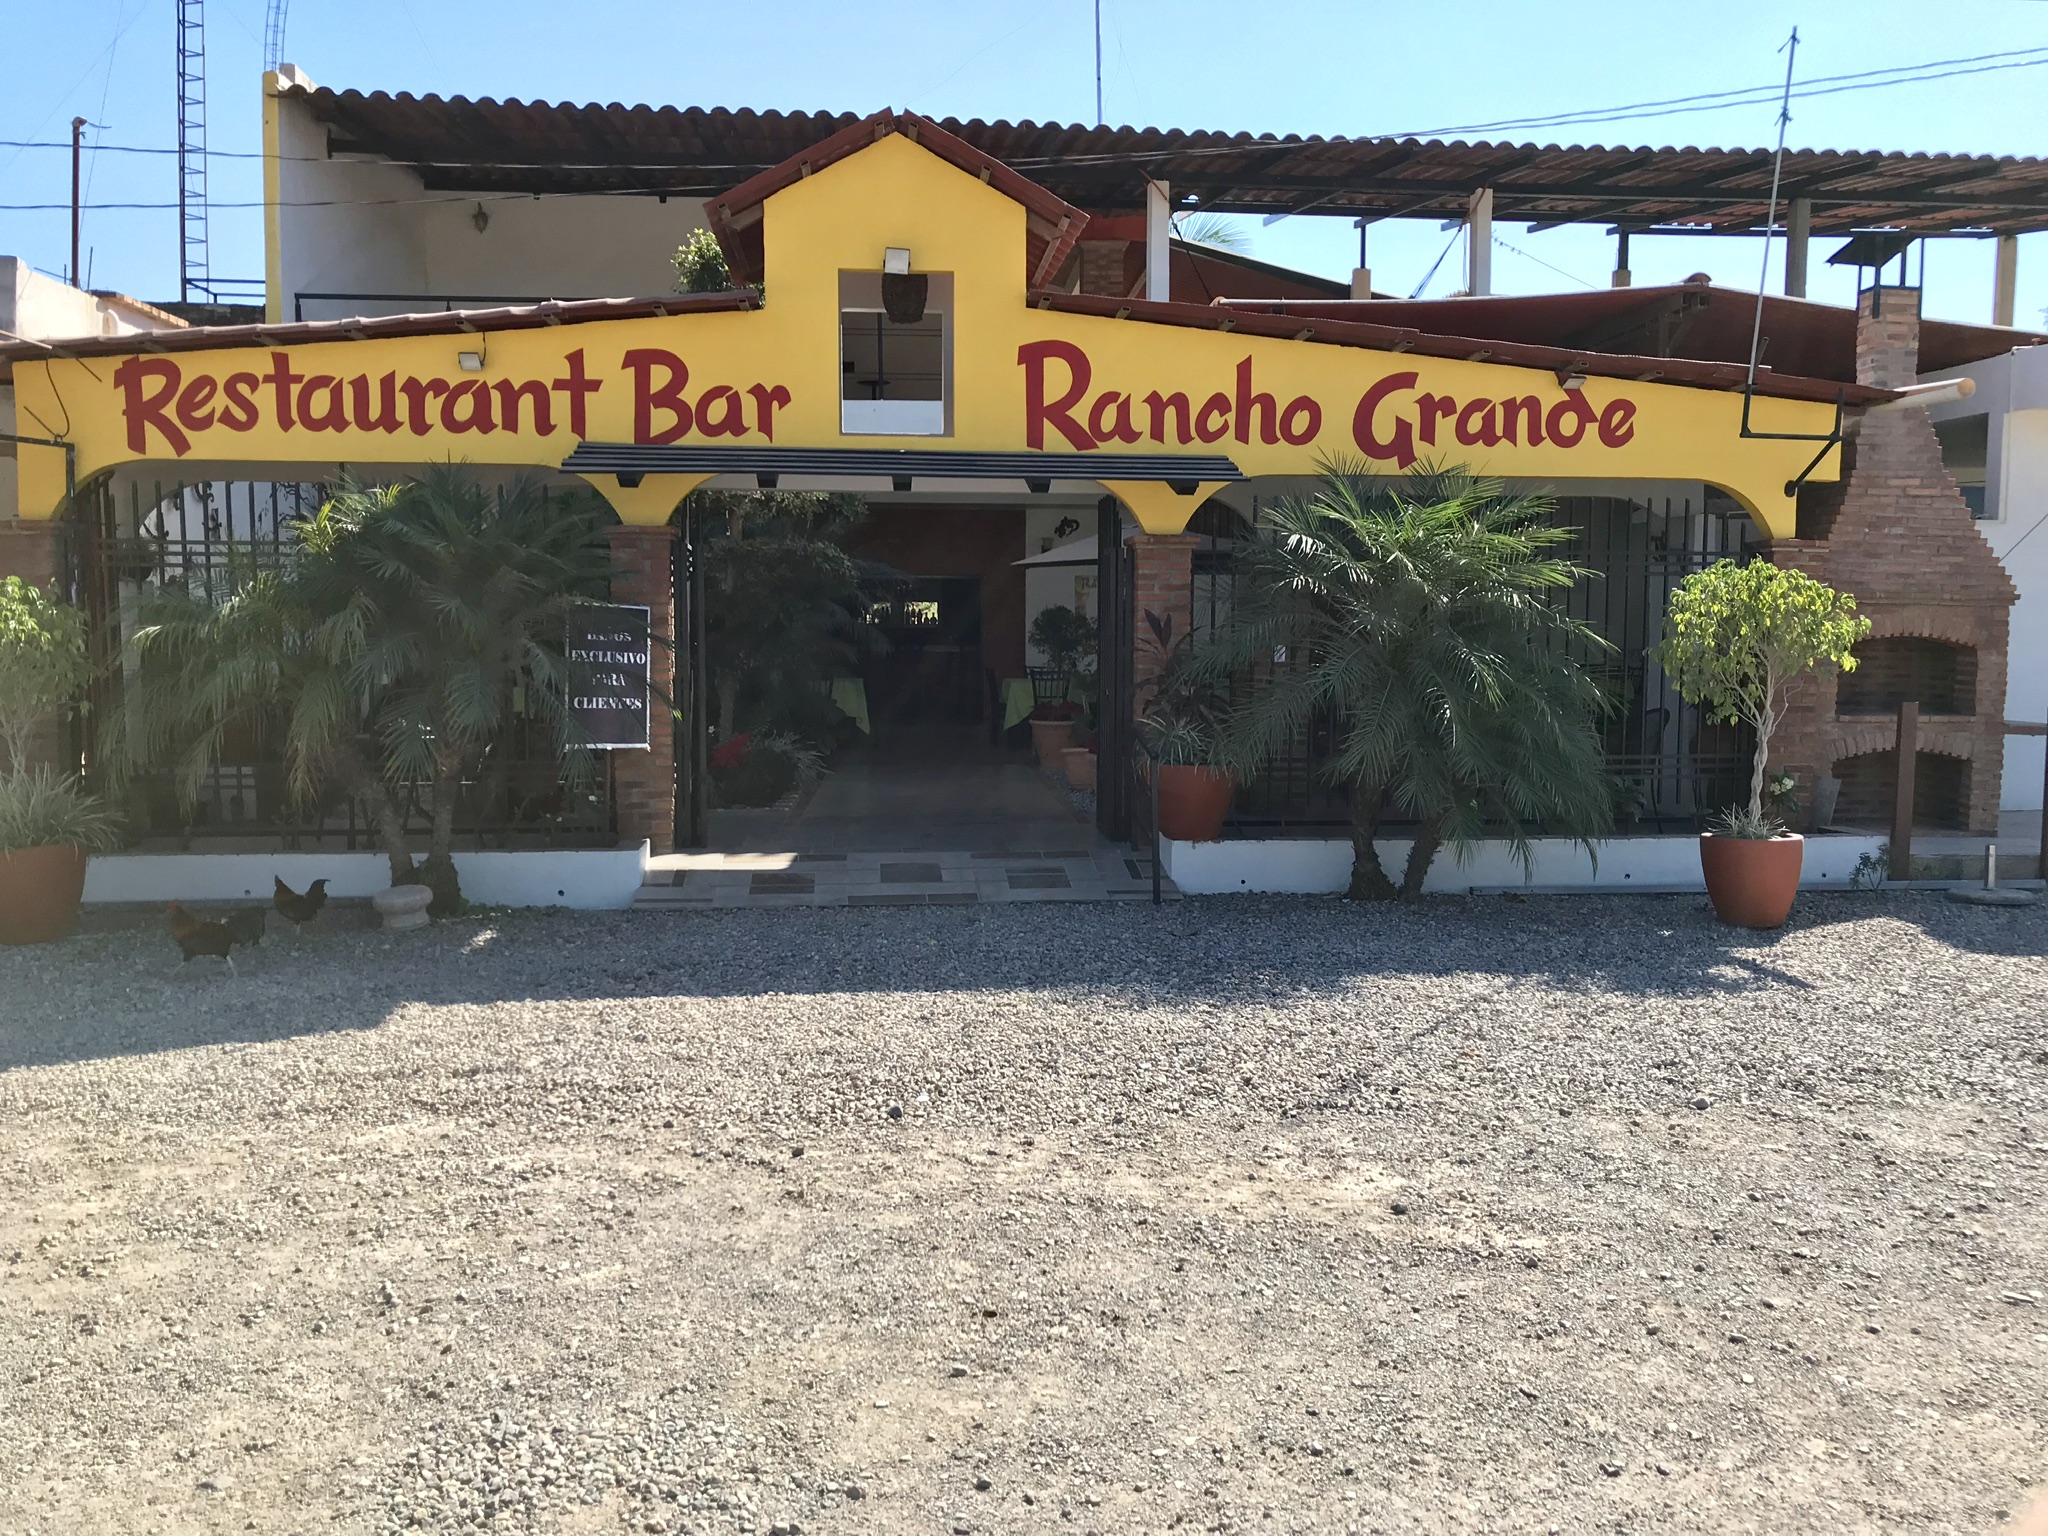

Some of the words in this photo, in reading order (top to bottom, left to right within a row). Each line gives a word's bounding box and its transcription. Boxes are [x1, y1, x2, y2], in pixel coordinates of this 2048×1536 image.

[115, 348, 603, 456] Restaurant
[621, 348, 792, 445] Bar
[1017, 340, 1322, 452] Rancho
[1353, 371, 1636, 470] Grande
[571, 650, 646, 664] EXCLUSIVO
[587, 629, 632, 642] BAOS
